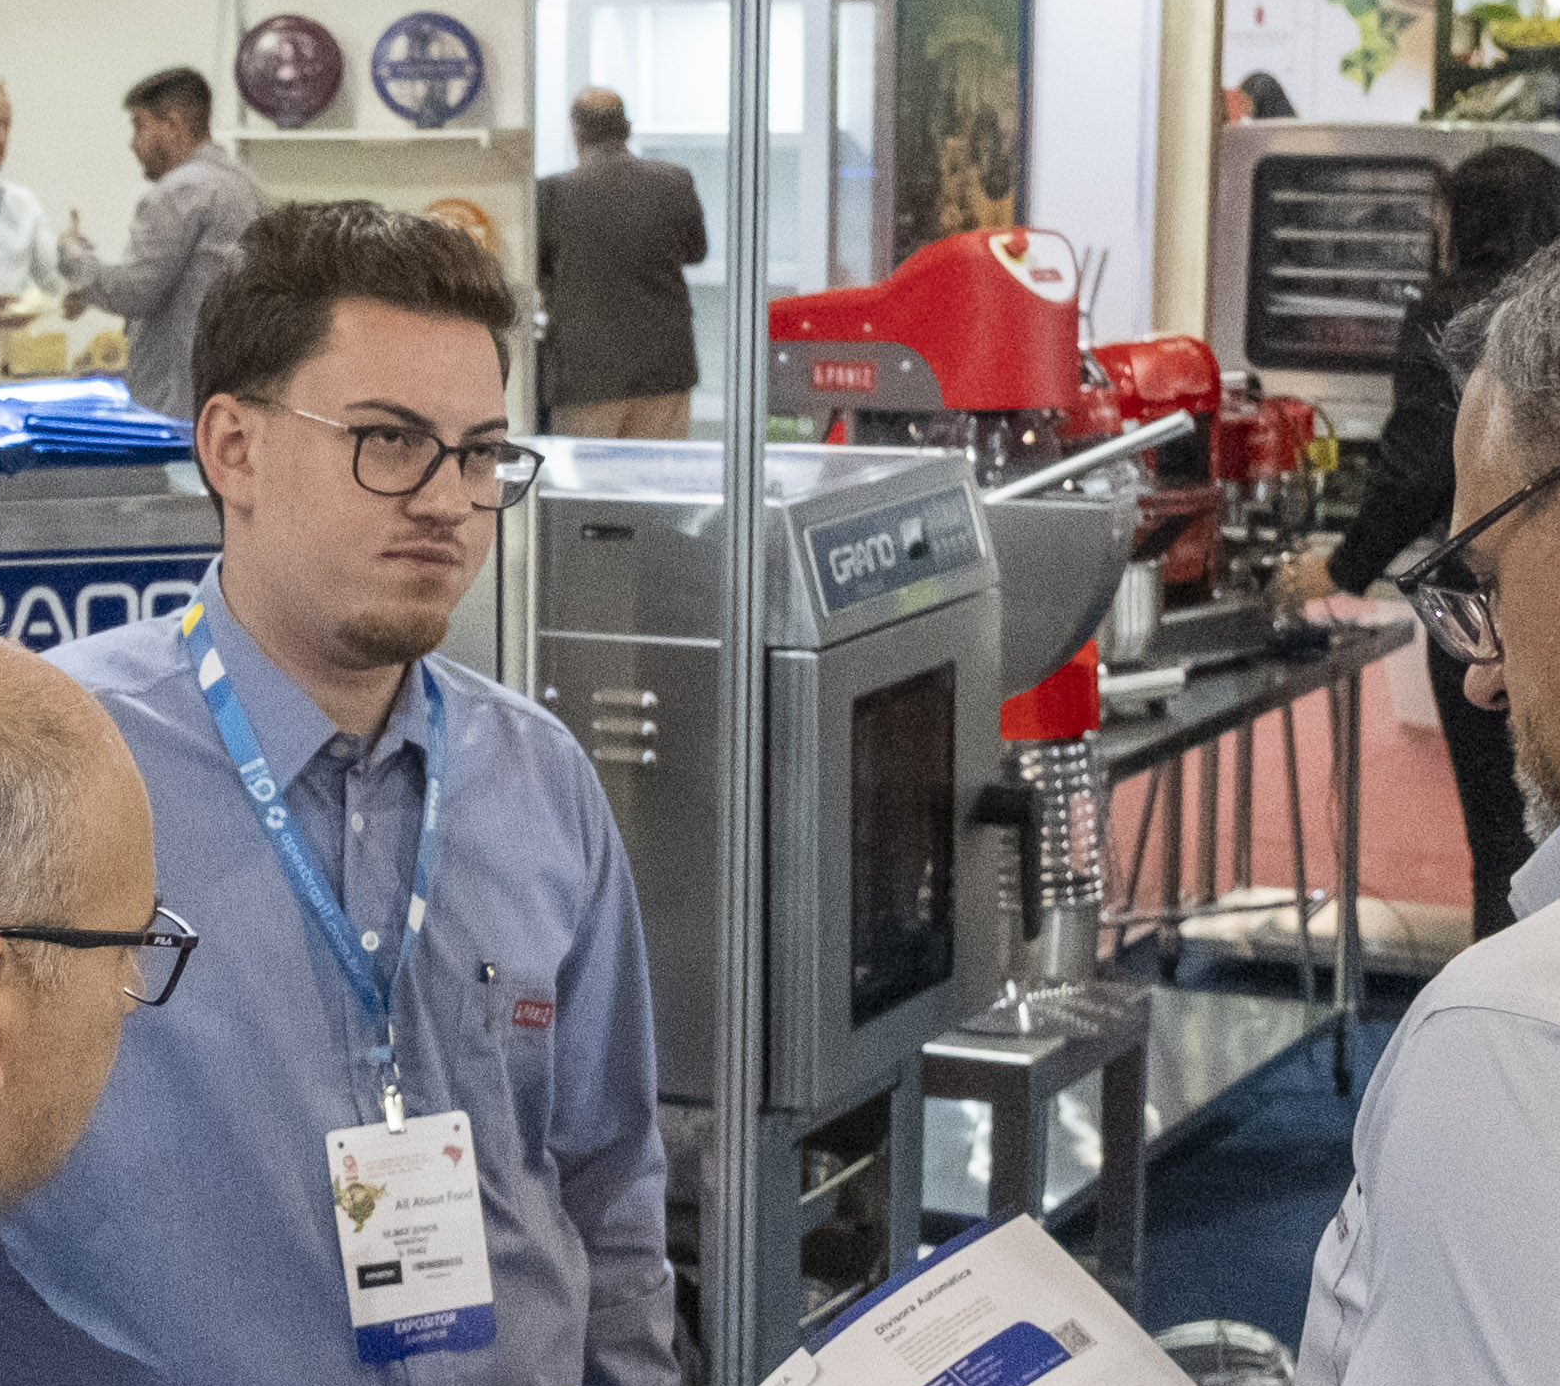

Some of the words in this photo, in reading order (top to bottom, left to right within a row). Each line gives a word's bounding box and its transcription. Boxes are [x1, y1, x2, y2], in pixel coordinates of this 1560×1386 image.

[829, 532, 897, 586] GRANO
[393, 1195, 411, 1213] All
[413, 1191, 445, 1209] About
[446, 1186, 475, 1205] Food
